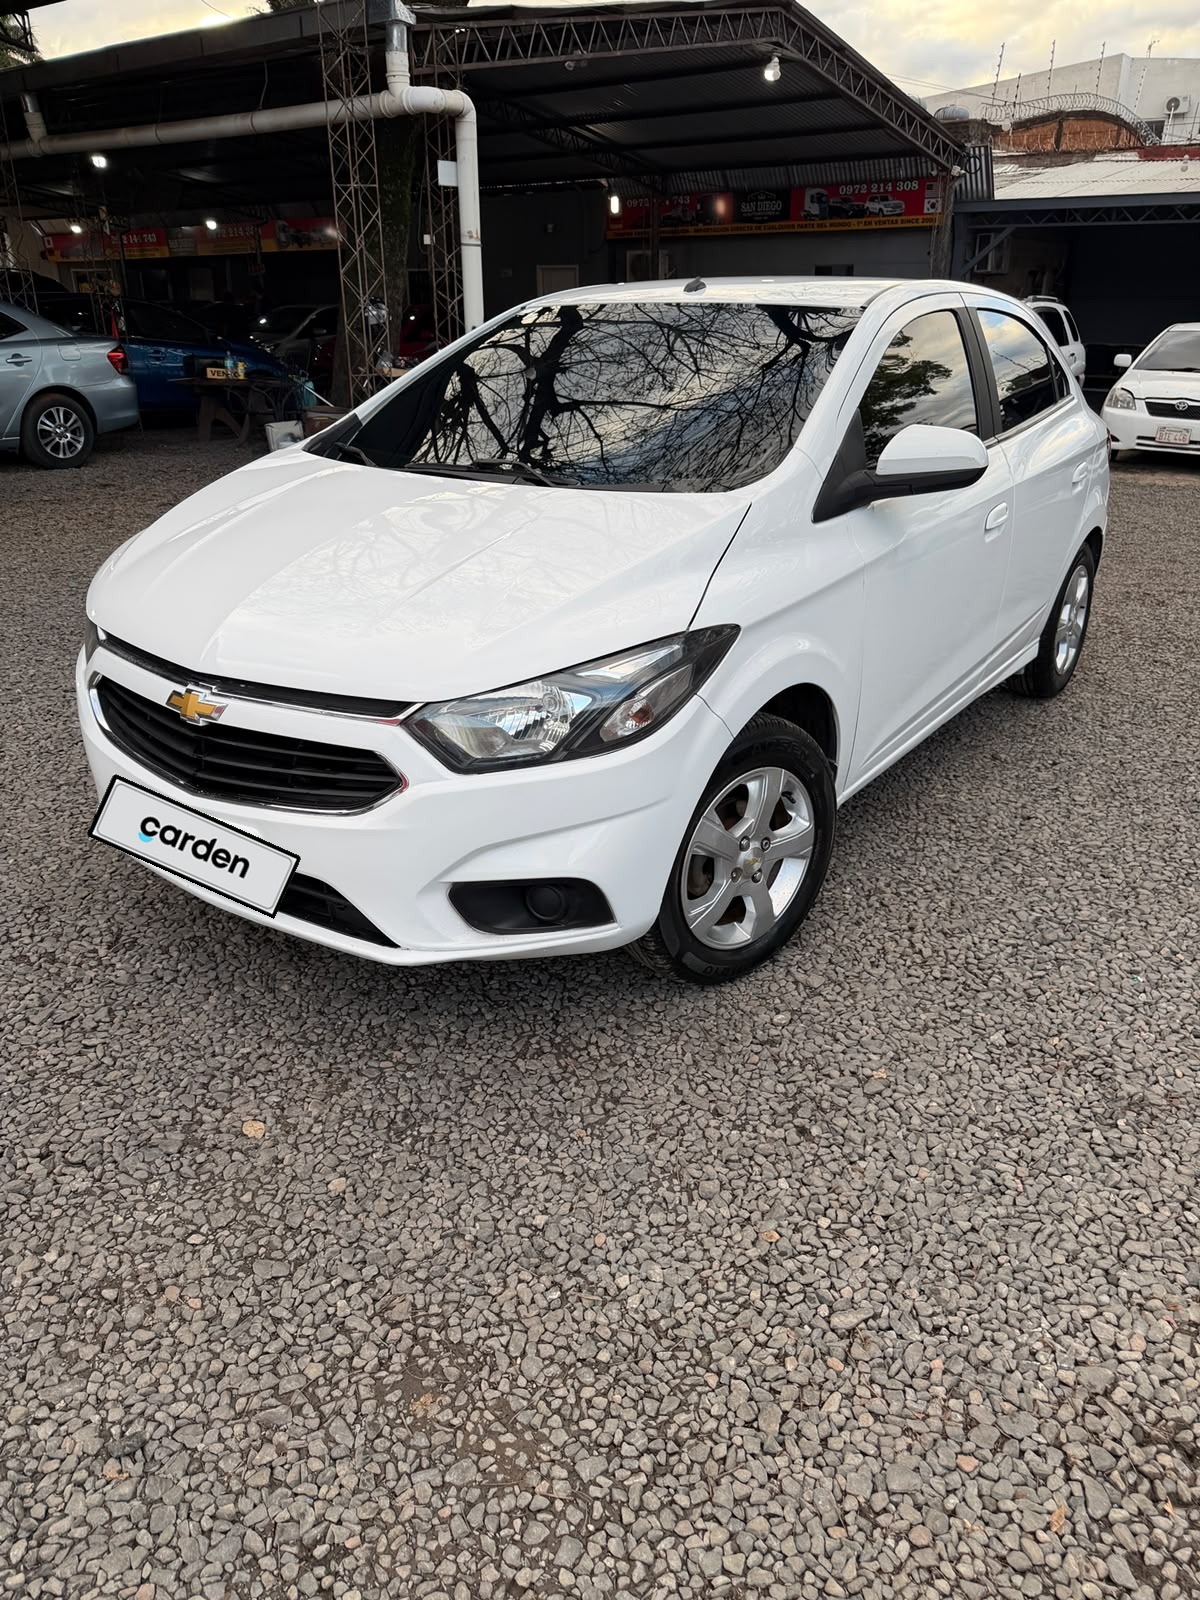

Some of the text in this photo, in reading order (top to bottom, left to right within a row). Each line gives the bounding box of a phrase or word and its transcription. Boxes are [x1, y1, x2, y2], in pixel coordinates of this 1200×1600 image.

[839, 180, 919, 195] 0972 214 308
[740, 199, 782, 213] SAN DIEGO
